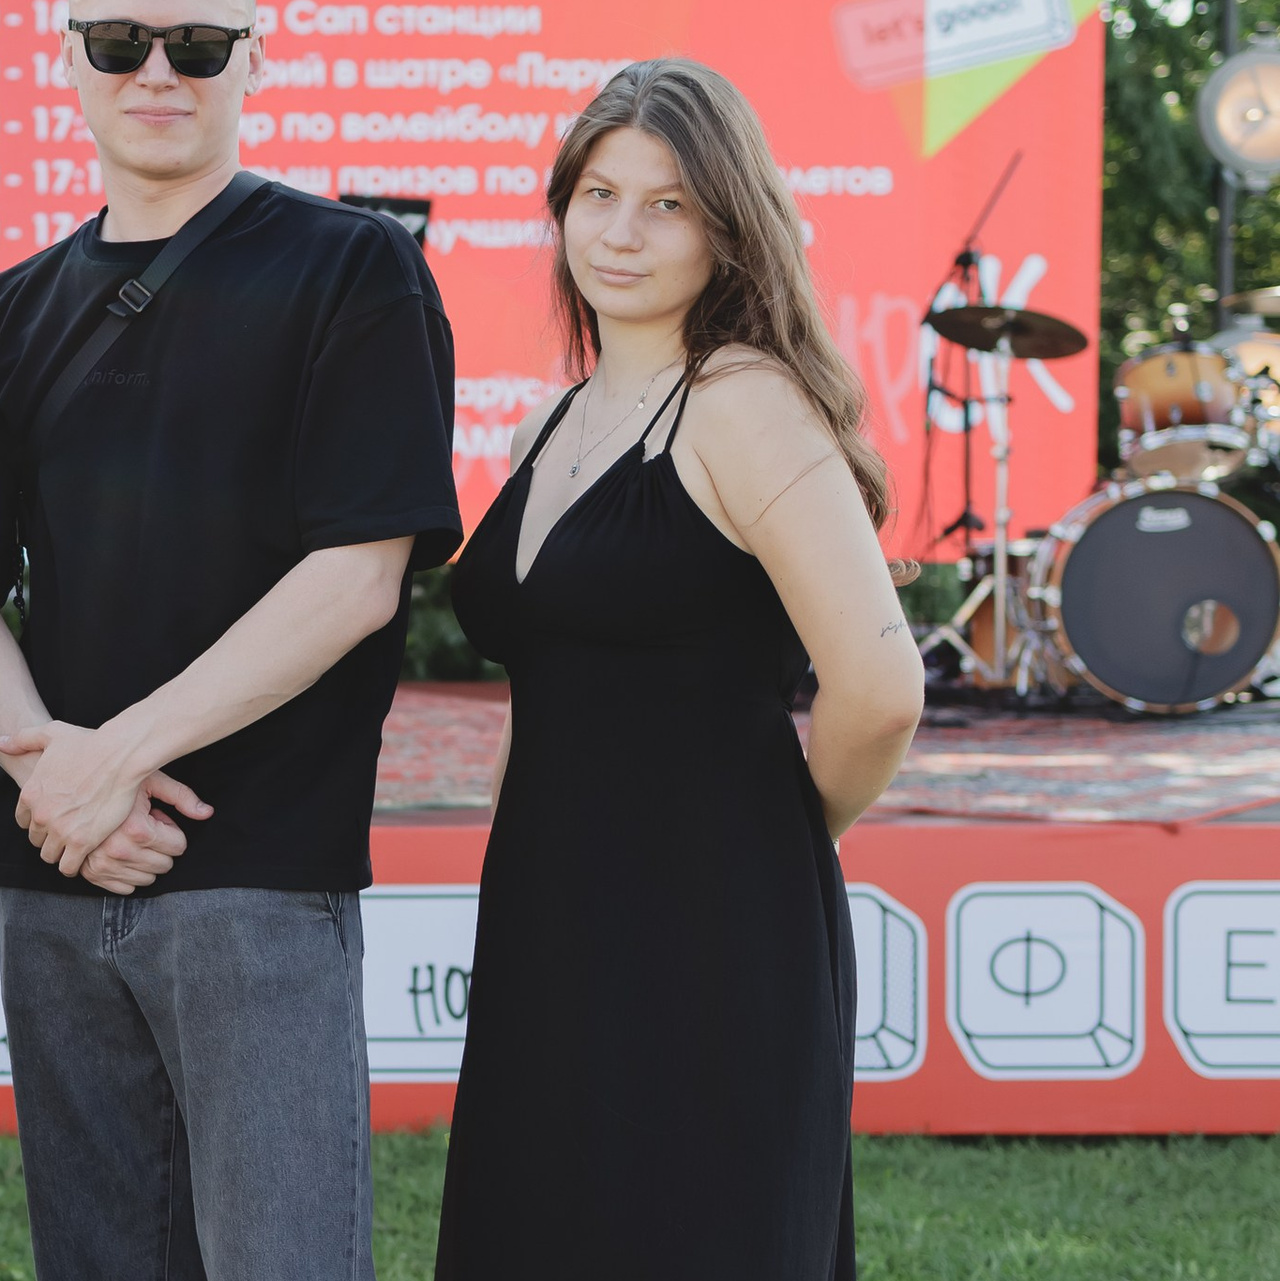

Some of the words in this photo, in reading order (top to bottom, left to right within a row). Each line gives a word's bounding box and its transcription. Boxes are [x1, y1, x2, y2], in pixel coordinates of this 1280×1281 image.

[374, 5, 542, 40] станции
[332, 59, 358, 88] в
[364, 59, 492, 94] шатре
[282, 112, 335, 142] по
[340, 104, 549, 148] волейболу
[338, 166, 479, 199] призов
[484, 166, 538, 195] по
